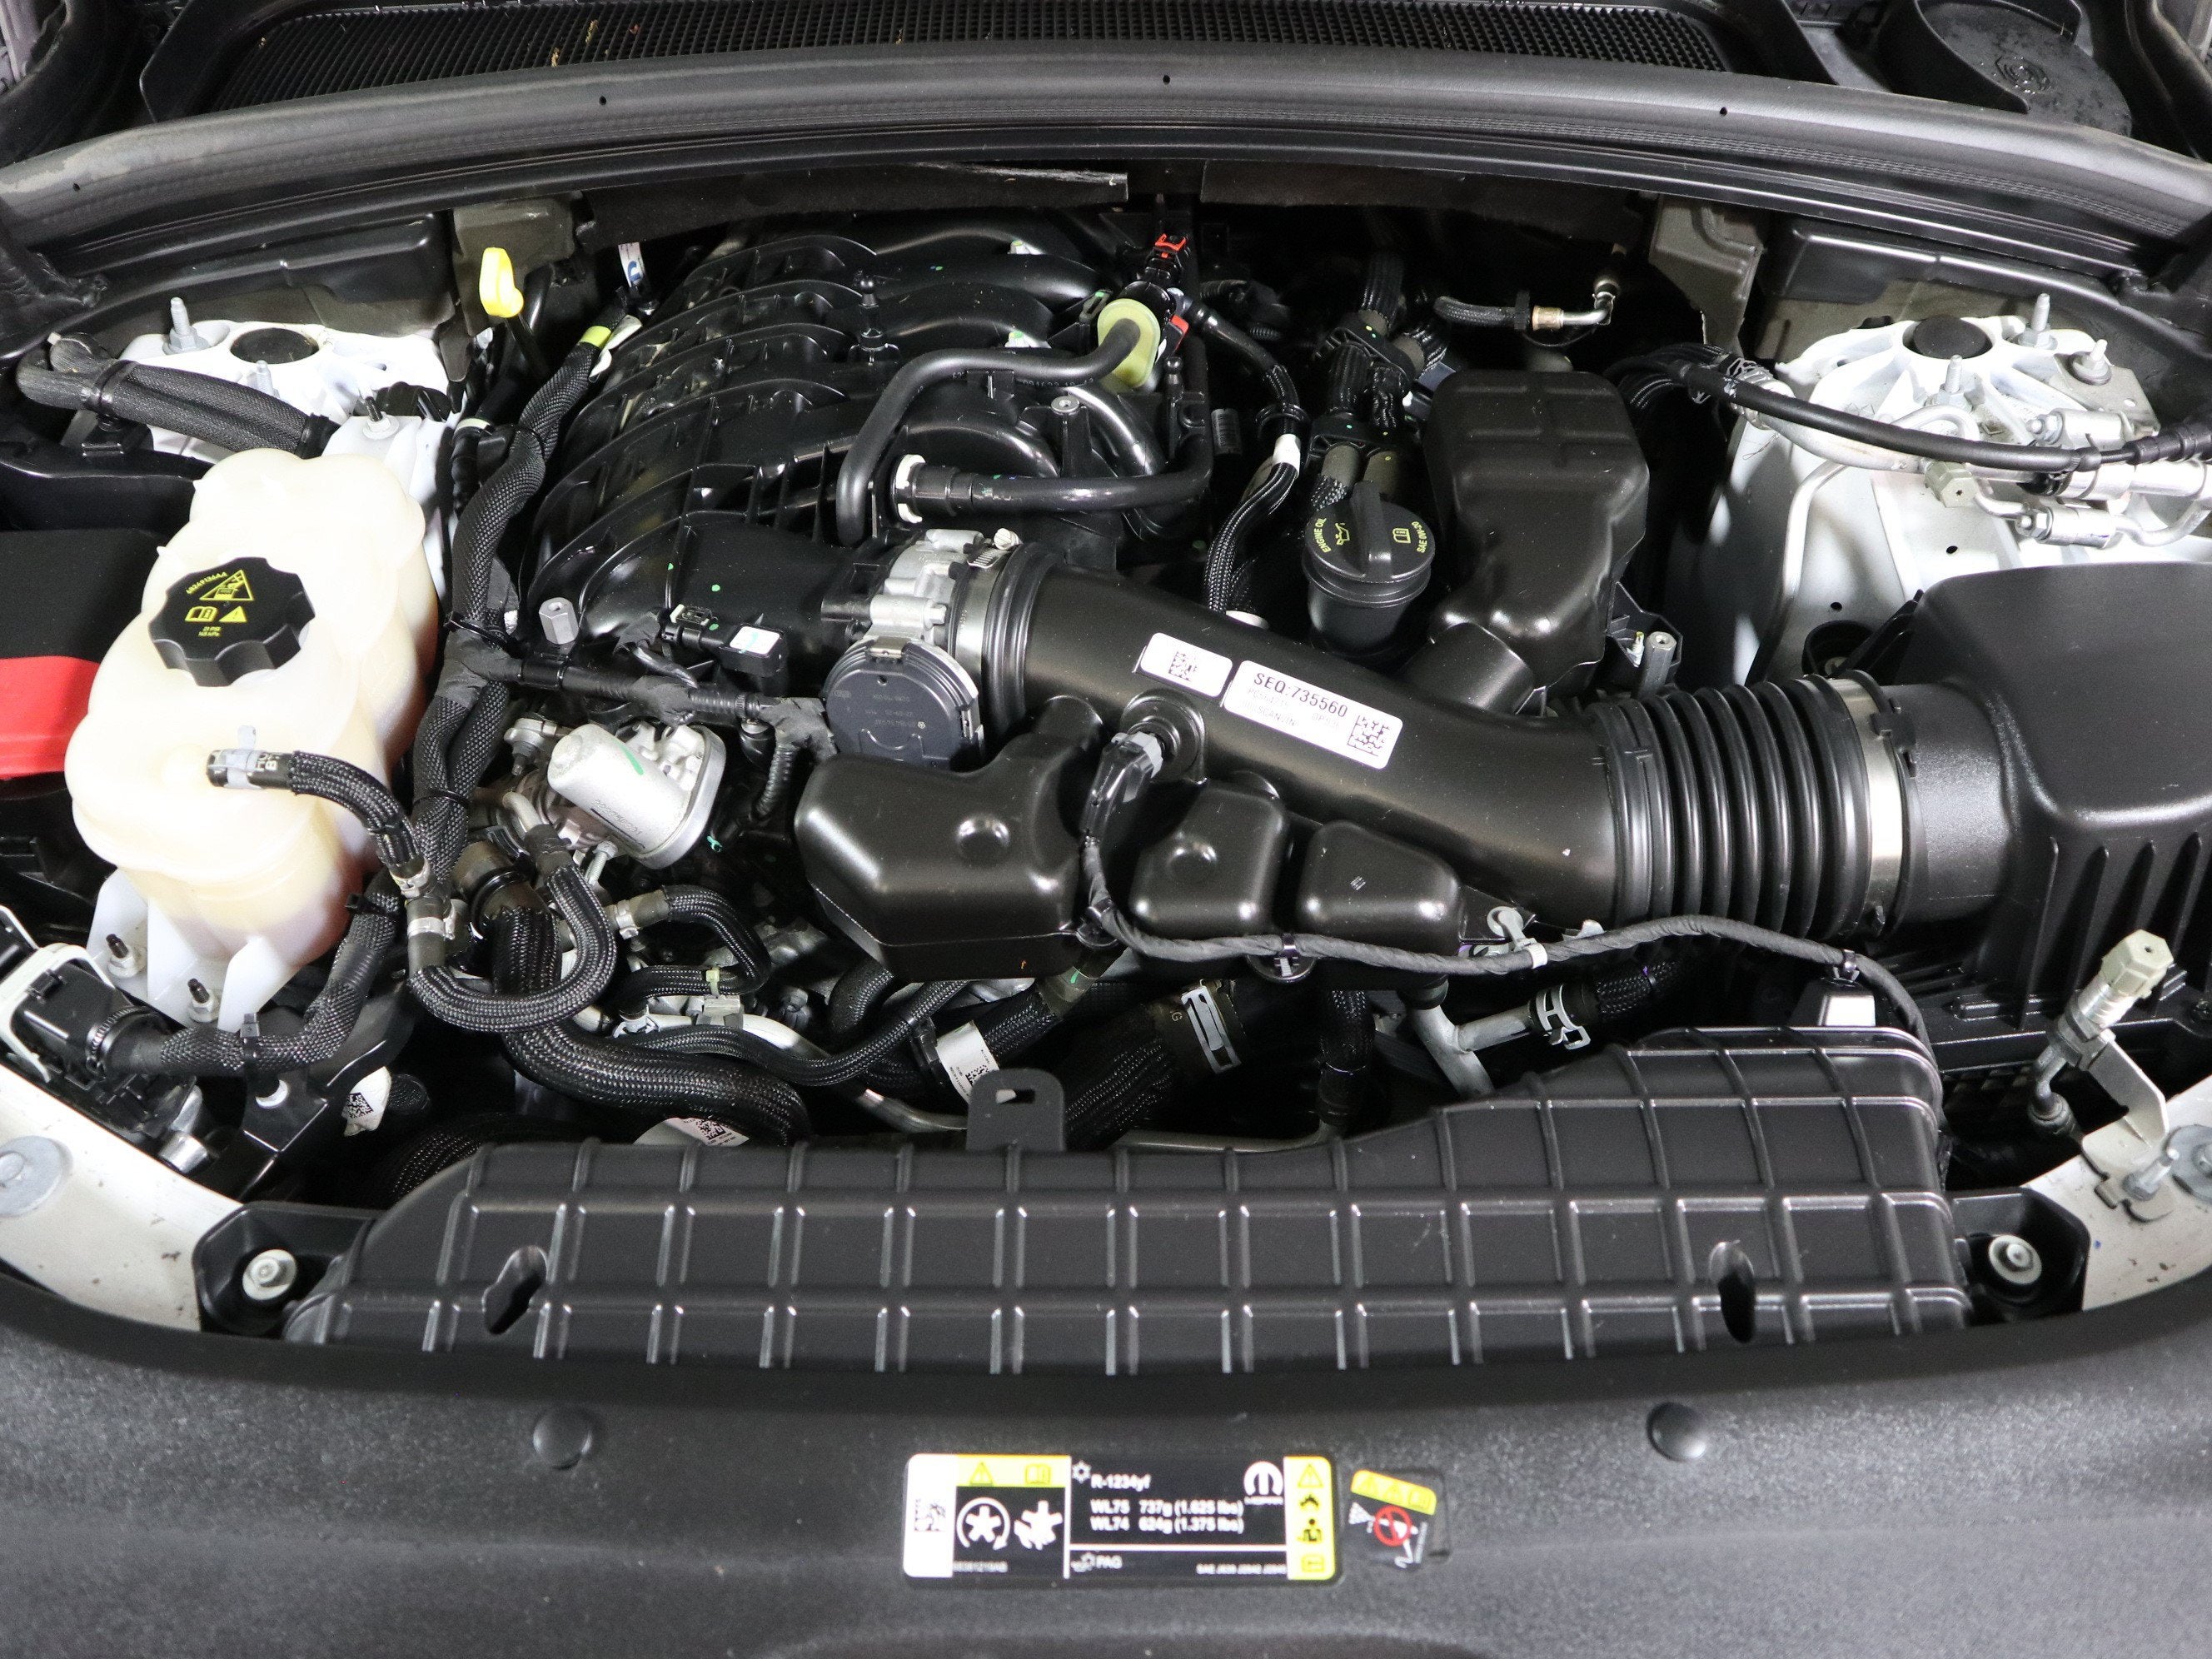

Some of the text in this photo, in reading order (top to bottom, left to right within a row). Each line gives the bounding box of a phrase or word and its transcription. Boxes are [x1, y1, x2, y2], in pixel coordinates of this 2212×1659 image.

[1313, 517, 1332, 553] ENGINE OIL
[1416, 539, 1427, 553] SAE
[1253, 671, 1348, 720] SEQ:735560
[1089, 1498, 1131, 1515] WL75
[1089, 1515, 1131, 1532] WL74
